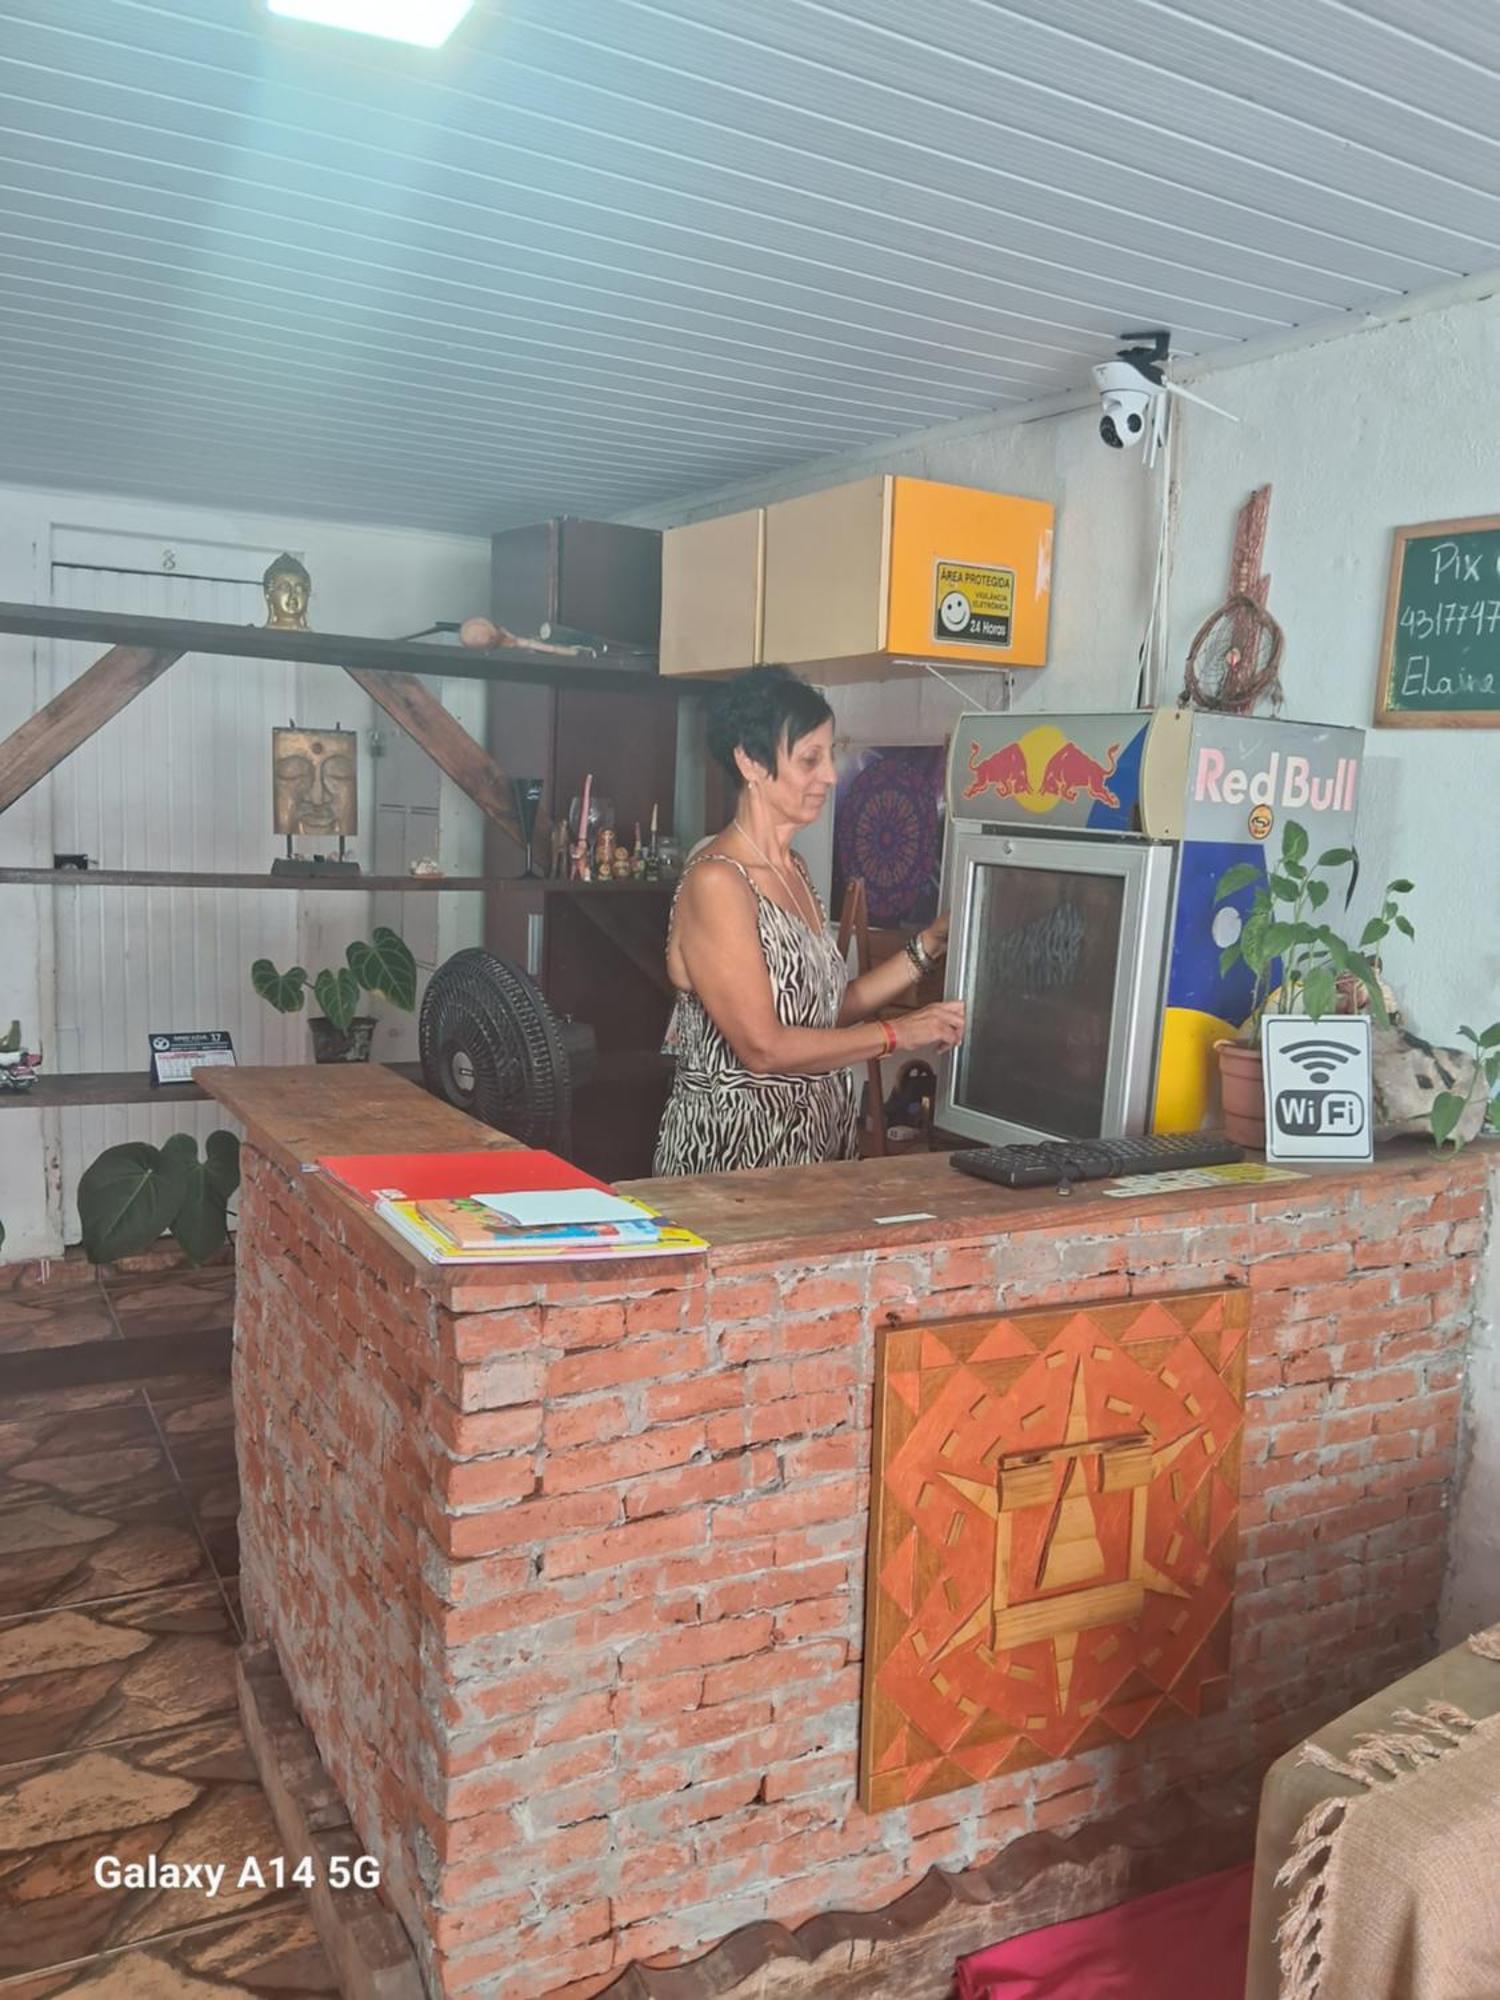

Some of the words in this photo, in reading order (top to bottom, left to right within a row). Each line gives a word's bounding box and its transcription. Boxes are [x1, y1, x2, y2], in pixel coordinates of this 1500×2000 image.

[965, 572, 1010, 588] PROTEGIDA
[970, 619, 981, 633] 24
[982, 620, 1007, 636] Horas
[1194, 747, 1279, 806] Red
[1281, 756, 1357, 811] Bull
